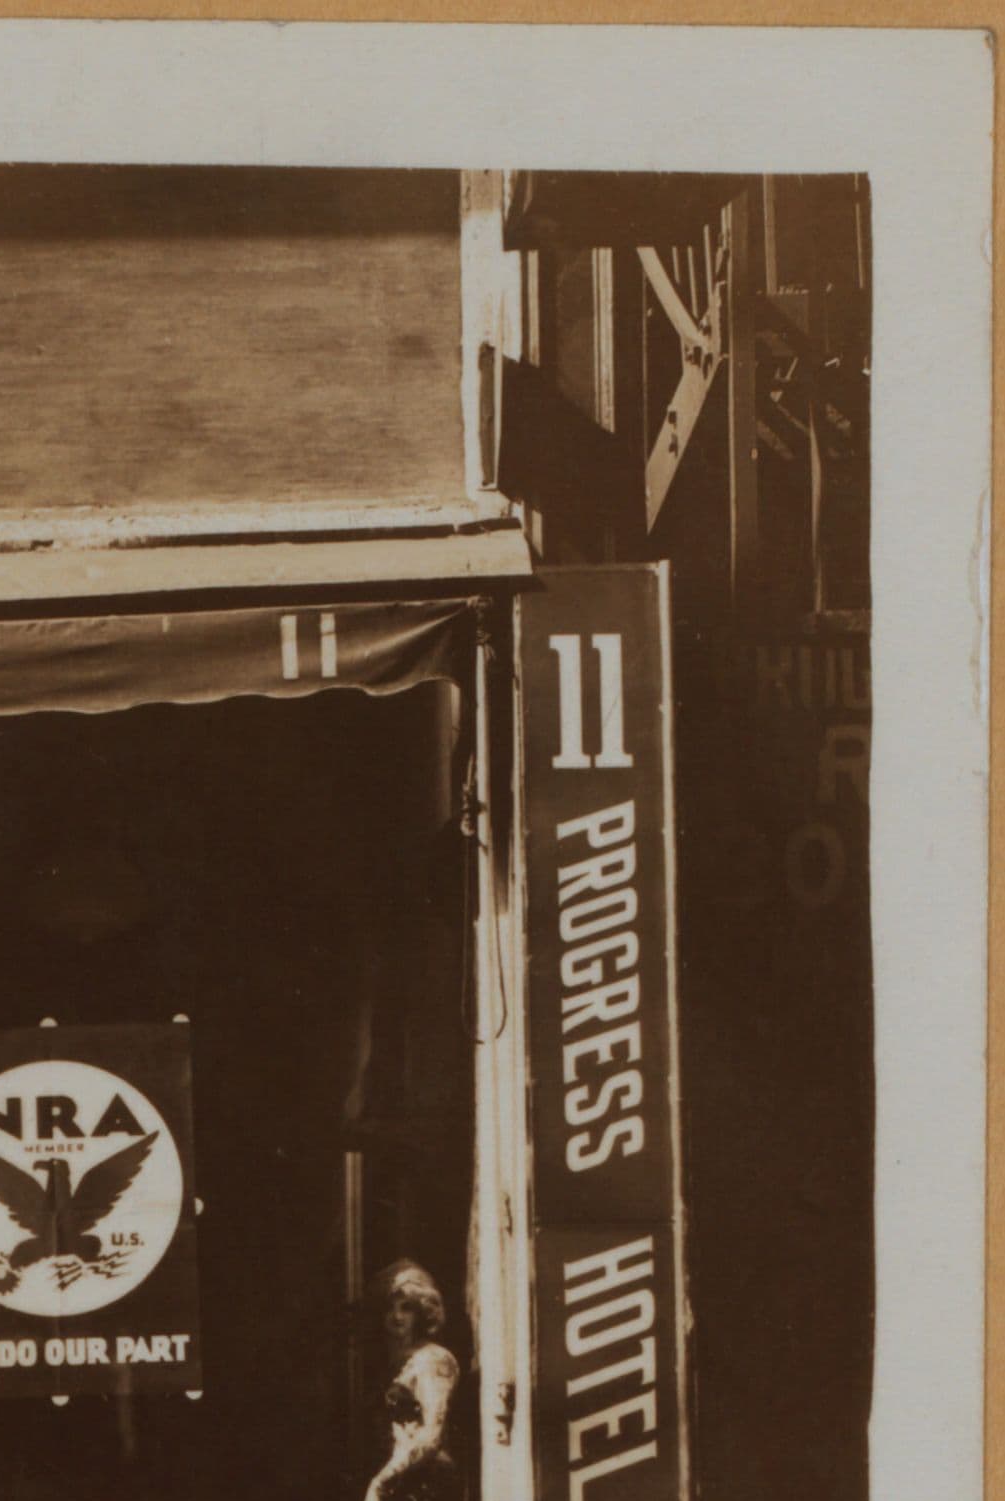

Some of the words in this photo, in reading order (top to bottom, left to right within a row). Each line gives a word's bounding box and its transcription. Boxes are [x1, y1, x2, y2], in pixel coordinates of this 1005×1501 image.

[549, 632, 634, 769] 11
[556, 799, 645, 1173] PROGRESS
[24, 1143, 86, 1153] MEMBER
[111, 1232, 145, 1247] U.S.
[45, 1337, 110, 1365] OUR
[116, 1334, 191, 1364] PART
